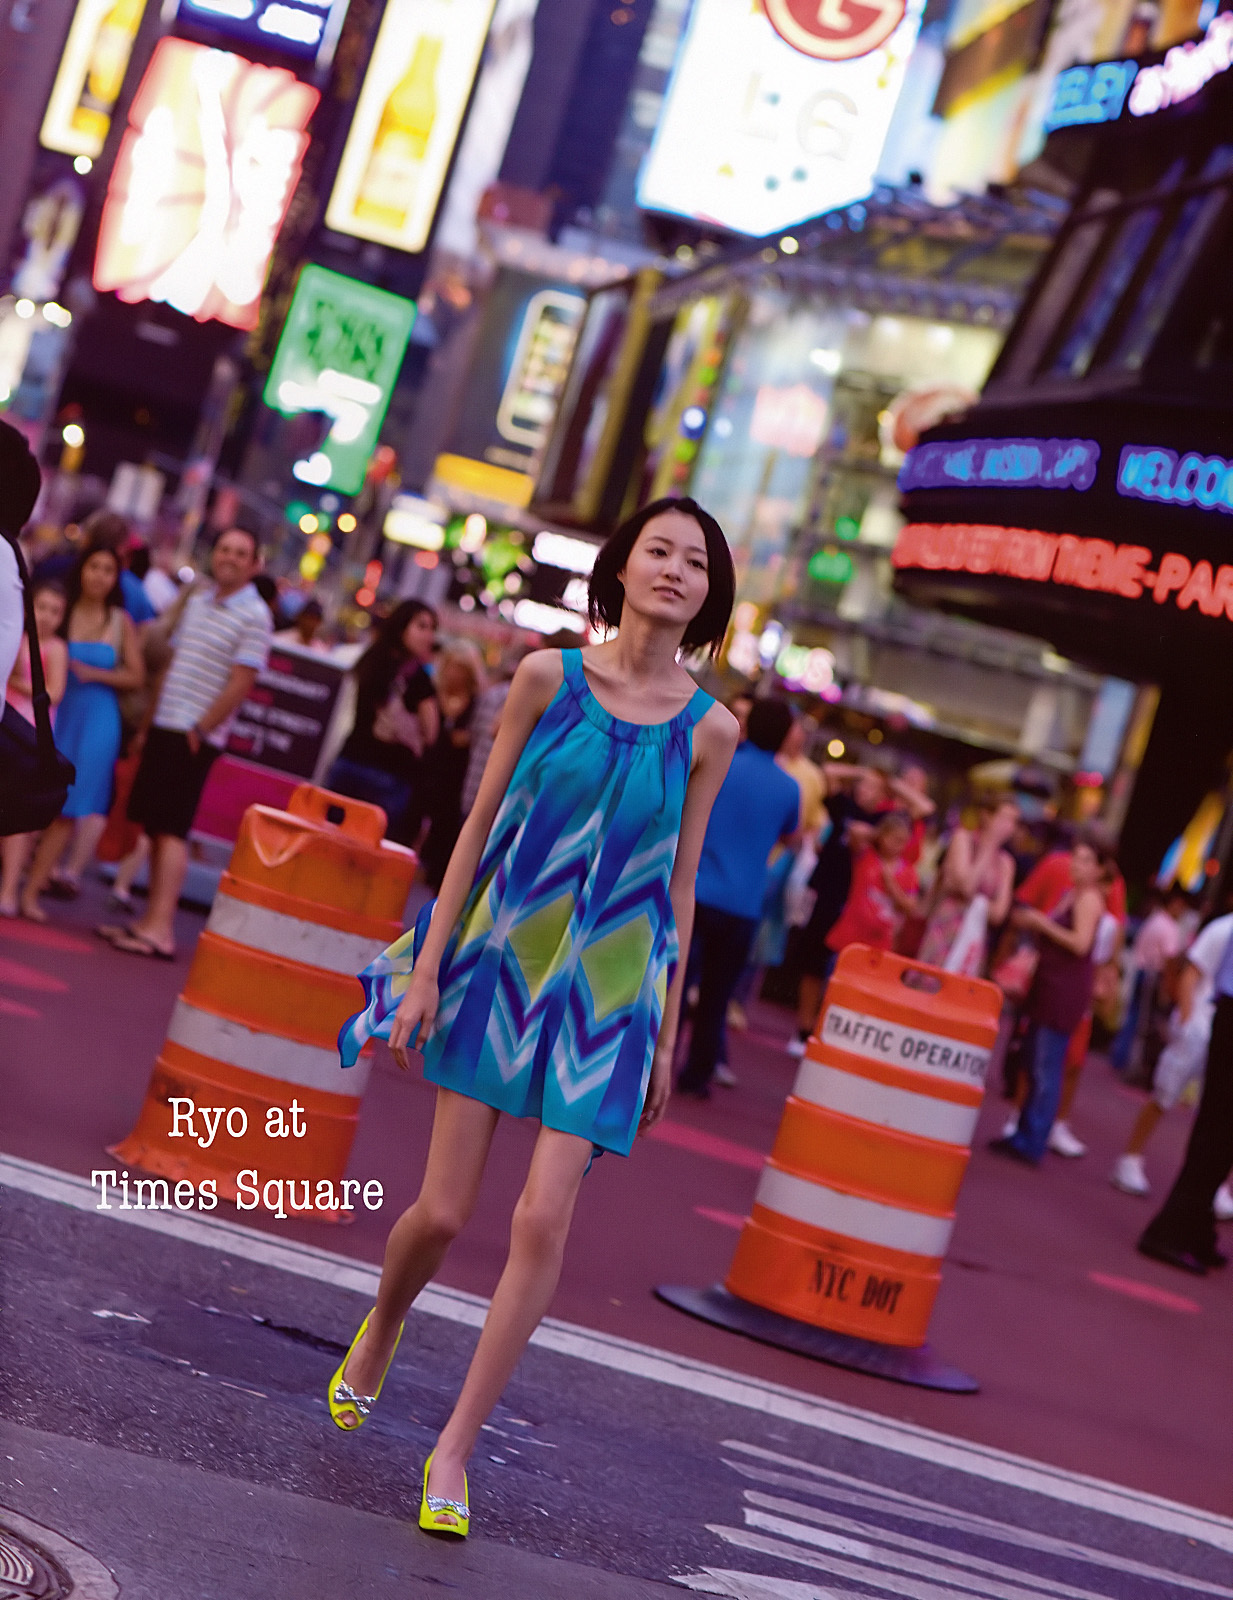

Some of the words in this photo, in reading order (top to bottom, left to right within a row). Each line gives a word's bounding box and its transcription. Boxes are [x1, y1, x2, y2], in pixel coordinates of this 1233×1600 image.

[828, 1012, 894, 1053] TRAFFIC
[809, 1260, 856, 1302] NYC
[861, 1273, 904, 1315] DOT
